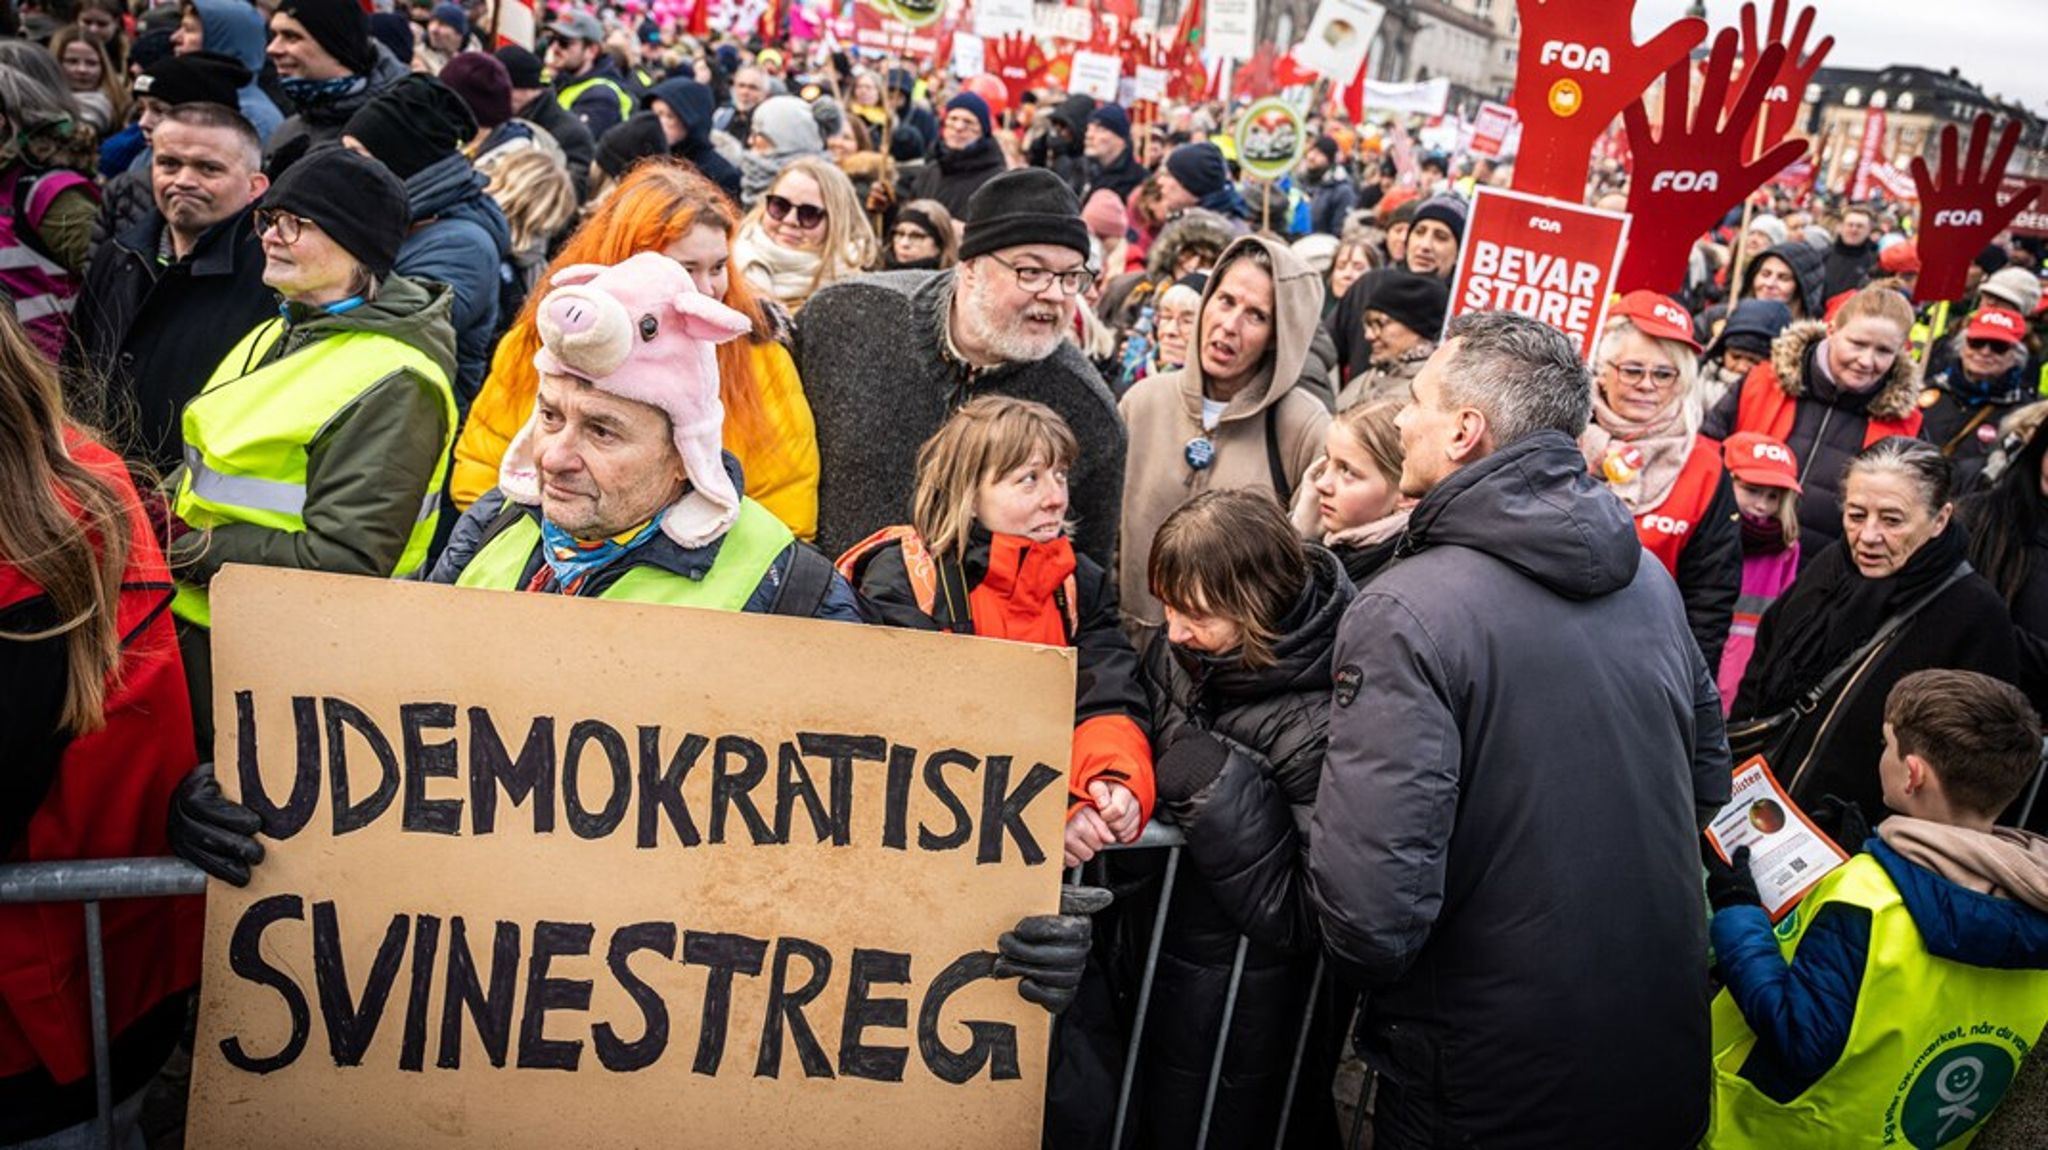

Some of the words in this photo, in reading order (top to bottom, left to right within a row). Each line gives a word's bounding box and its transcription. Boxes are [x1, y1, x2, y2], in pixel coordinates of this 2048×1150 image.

[1540, 40, 1611, 74] FOA
[1651, 170, 1719, 192] FOA
[1529, 216, 1562, 234] FOA
[1934, 209, 1983, 226] FOA
[1472, 240, 1600, 298] BEVAR
[1464, 275, 1592, 332] STORE
[1653, 303, 1688, 331] FOA
[1752, 443, 1792, 465] FOA
[235, 690, 1062, 865] UDEMOKRATISK
[218, 893, 1021, 1085] SVINESTREG
[1970, 1022, 1995, 1036] når
[1996, 1026, 2013, 1040] du
[1935, 1055, 1984, 1142] OK
